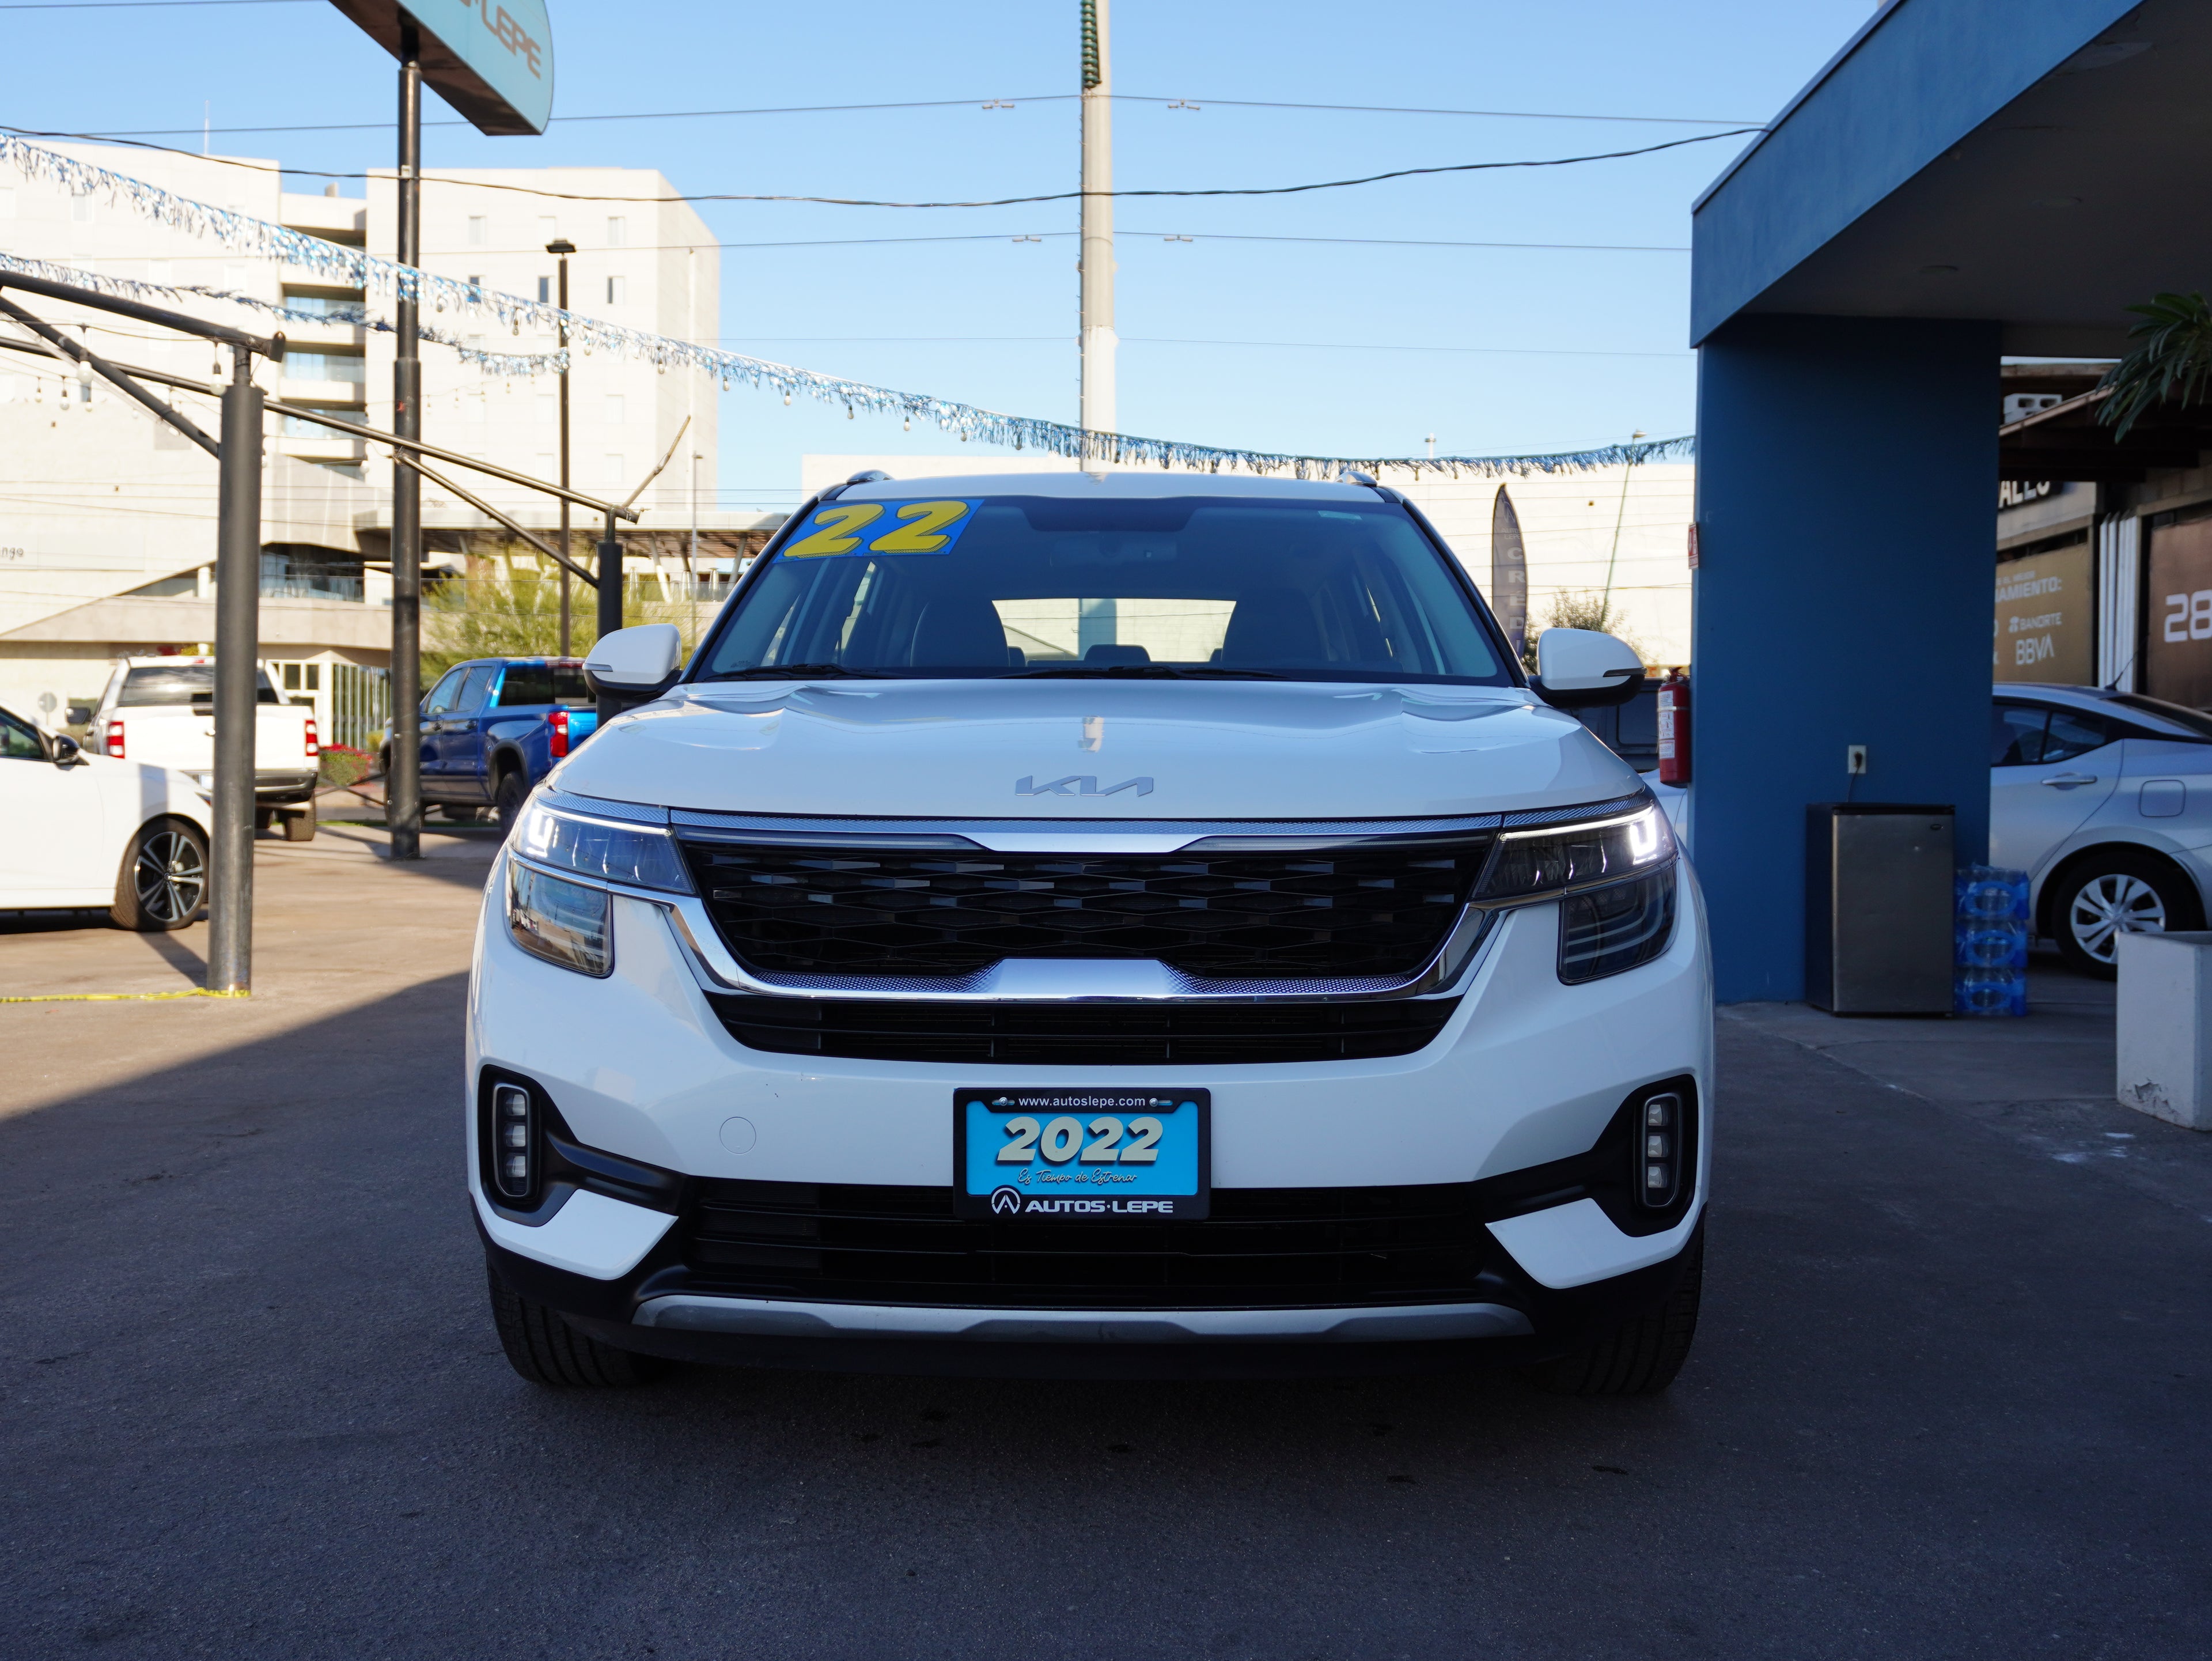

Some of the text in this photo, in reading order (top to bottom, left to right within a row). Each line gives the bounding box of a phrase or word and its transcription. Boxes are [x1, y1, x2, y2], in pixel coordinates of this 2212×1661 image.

[783, 500, 970, 559] 22
[2164, 589, 2212, 642] 28
[2016, 634, 2055, 665] BBVA
[1015, 775, 1154, 797] KIA
[1018, 1096, 1146, 1108] www.autoslepe.com
[997, 1116, 1164, 1162] 2022
[1018, 1168, 1138, 1185] Es Tiempo de Estrenar
